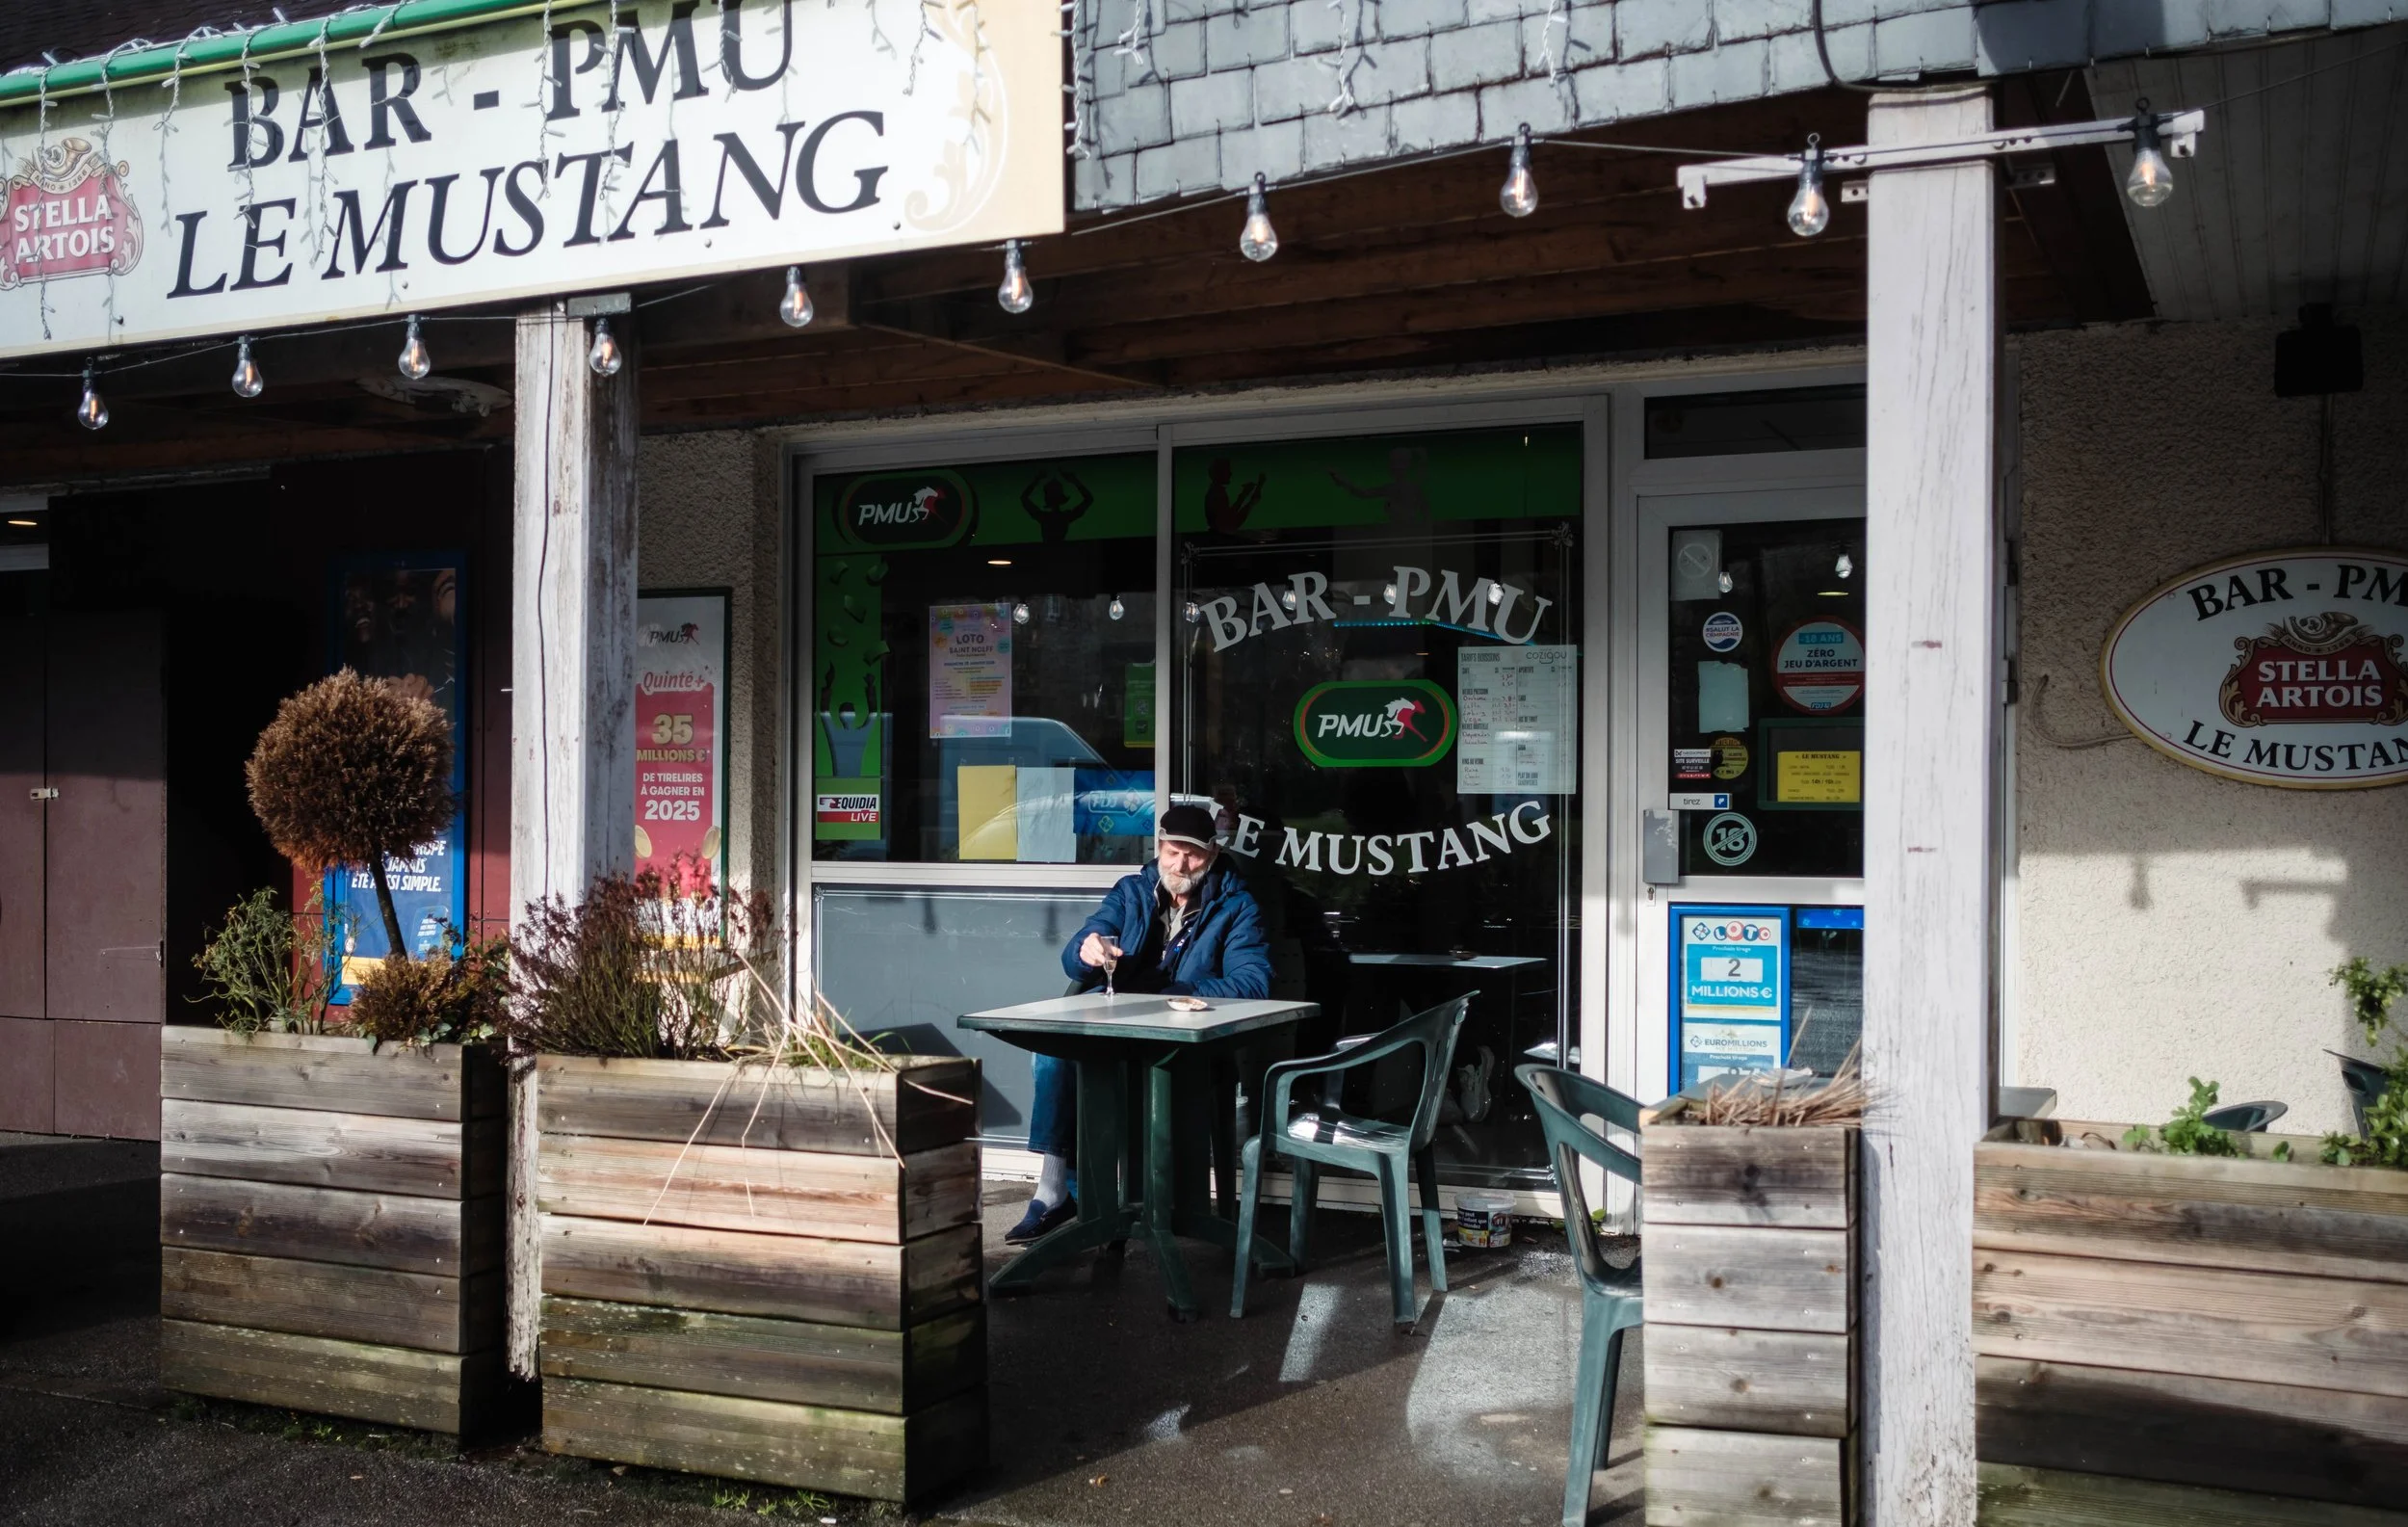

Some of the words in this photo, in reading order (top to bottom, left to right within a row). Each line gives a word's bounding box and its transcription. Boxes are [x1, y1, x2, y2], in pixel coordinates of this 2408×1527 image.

[224, 52, 432, 170] BAR
[473, 90, 499, 111] -
[546, 0, 793, 121] PMU
[14, 194, 114, 232] STELLA
[166, 197, 295, 300] LE
[321, 110, 889, 280] MUSTANG
[13, 223, 117, 265] ARTOIS
[858, 501, 913, 526] PMU
[2186, 566, 2293, 621] BAR
[2306, 582, 2320, 591] -
[1200, 569, 1336, 653] BAR
[1353, 594, 1371, 605] -
[1388, 565, 1553, 645] PMU
[649, 630, 680, 644] PMU
[955, 633, 984, 645] LOTO
[1820, 632, 1843, 643] ANS
[1806, 647, 1836, 658] ZÉRO
[1784, 660, 1803, 669] JEU
[1805, 658, 1858, 669] D'ARGENT
[2257, 659, 2383, 682] STELLA
[2256, 685, 2383, 708] ARTOIS
[651, 713, 694, 746] 35
[1318, 713, 1382, 739] PMU
[2183, 720, 2236, 759] LE
[636, 749, 694, 763] MILLIONS
[642, 773, 656, 783] DE
[657, 773, 703, 783] TIRELIRES
[640, 783, 648, 797] À
[649, 785, 690, 797] GAGNER
[692, 785, 705, 797] EN
[644, 800, 701, 822] 2025
[834, 796, 877, 810] EQUIDIA
[850, 812, 877, 822] LIVE
[1275, 800, 1552, 876] MUSTANG
[1715, 827, 1745, 852] 18
[401, 876, 442, 892] SIMPLE.
[1713, 920, 1772, 941] LOTO
[1727, 958, 1741, 978] 2
[1691, 985, 1759, 998] MILLIONS
[1760, 987, 1772, 999] €
[1704, 1038, 1768, 1049] EUROMILLIONS
